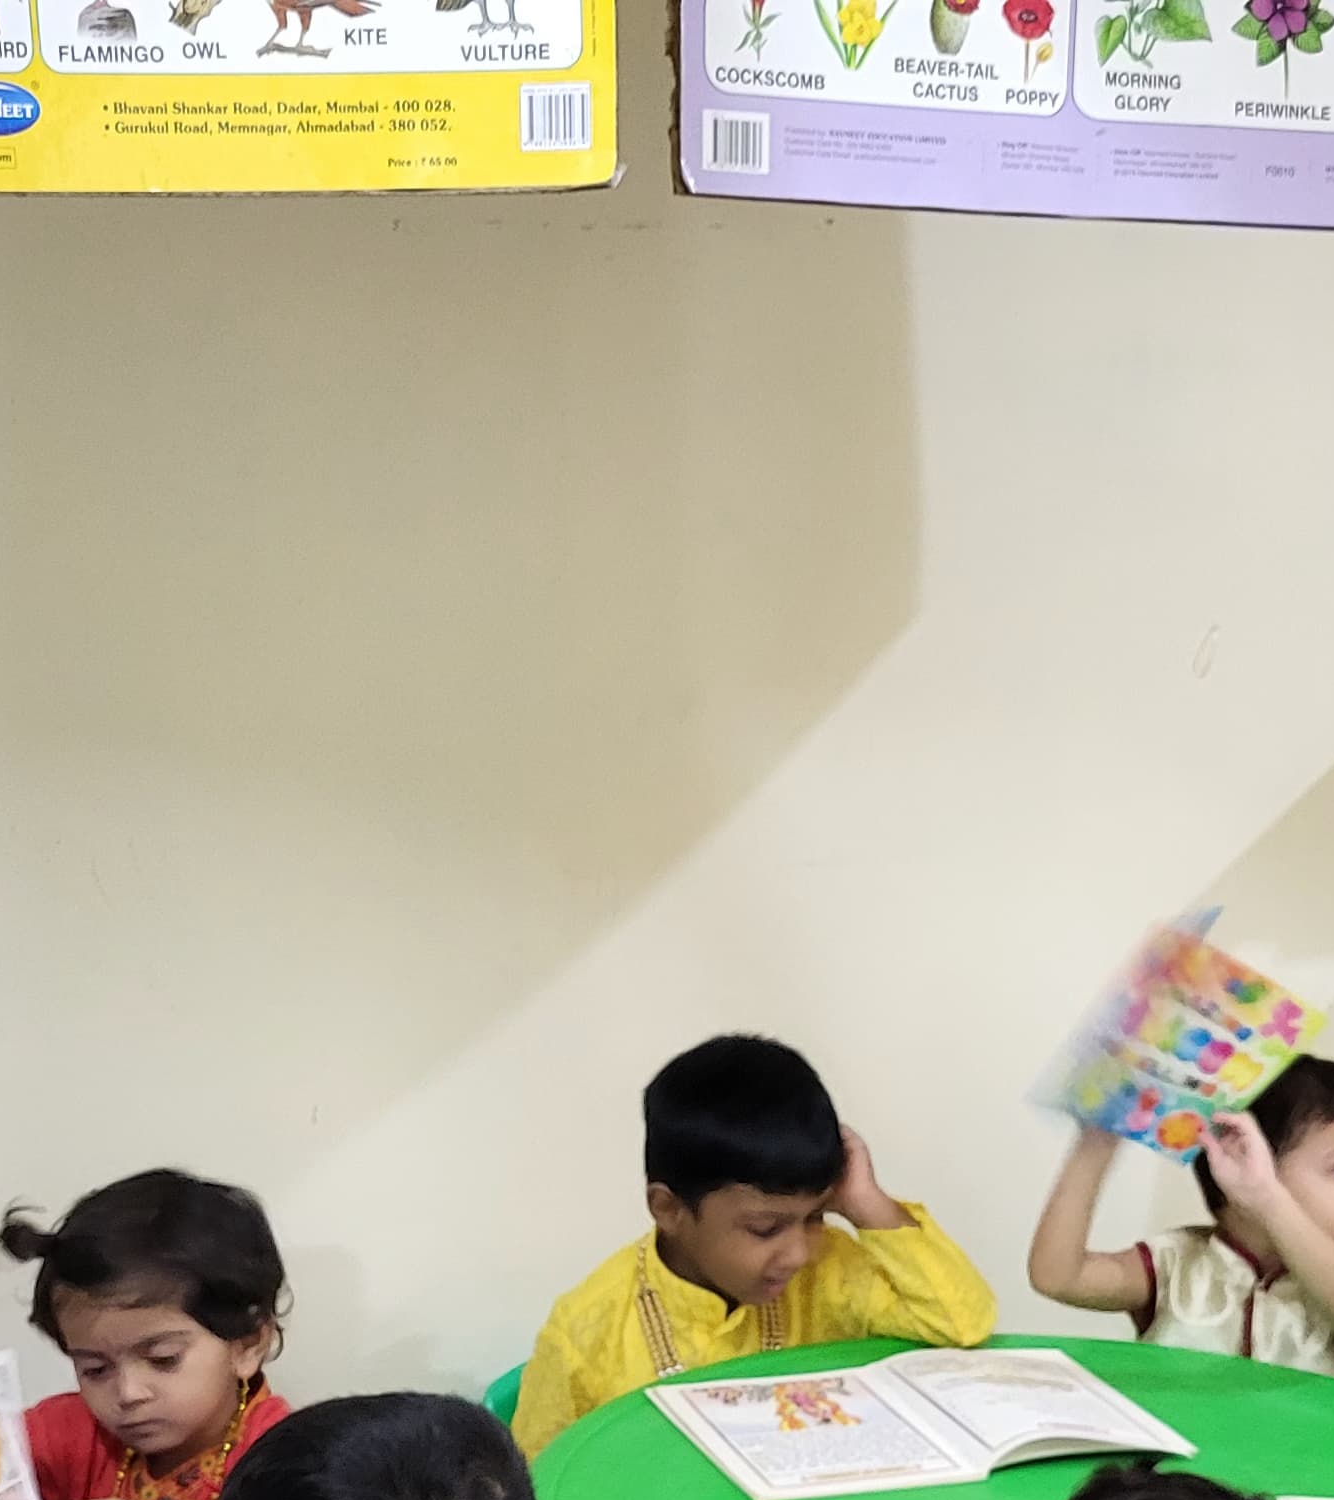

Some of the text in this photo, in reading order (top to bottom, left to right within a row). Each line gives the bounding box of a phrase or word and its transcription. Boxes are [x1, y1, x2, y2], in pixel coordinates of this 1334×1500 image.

[344, 27, 388, 46] KITE
[58, 44, 165, 63] FLAMINGO
[182, 42, 228, 60] OWL
[461, 43, 550, 62] VULTURE
[715, 66, 826, 91] COCKSCOMB
[893, 57, 1000, 81] BEAVER-TAIL
[1104, 71, 1182, 91] MORNING
[912, 82, 979, 102] CACTUS
[1004, 88, 1061, 108] POPPY
[113, 101, 169, 115] Bhavani
[172, 101, 228, 115] Shankar
[325, 100, 380, 114] Mumbai
[392, 99, 420, 113] 400
[1114, 94, 1171, 113] GLORY
[1234, 101, 1332, 122] PERIWINKLE
[114, 120, 169, 134] Gurukul
[388, 118, 416, 132] 380
